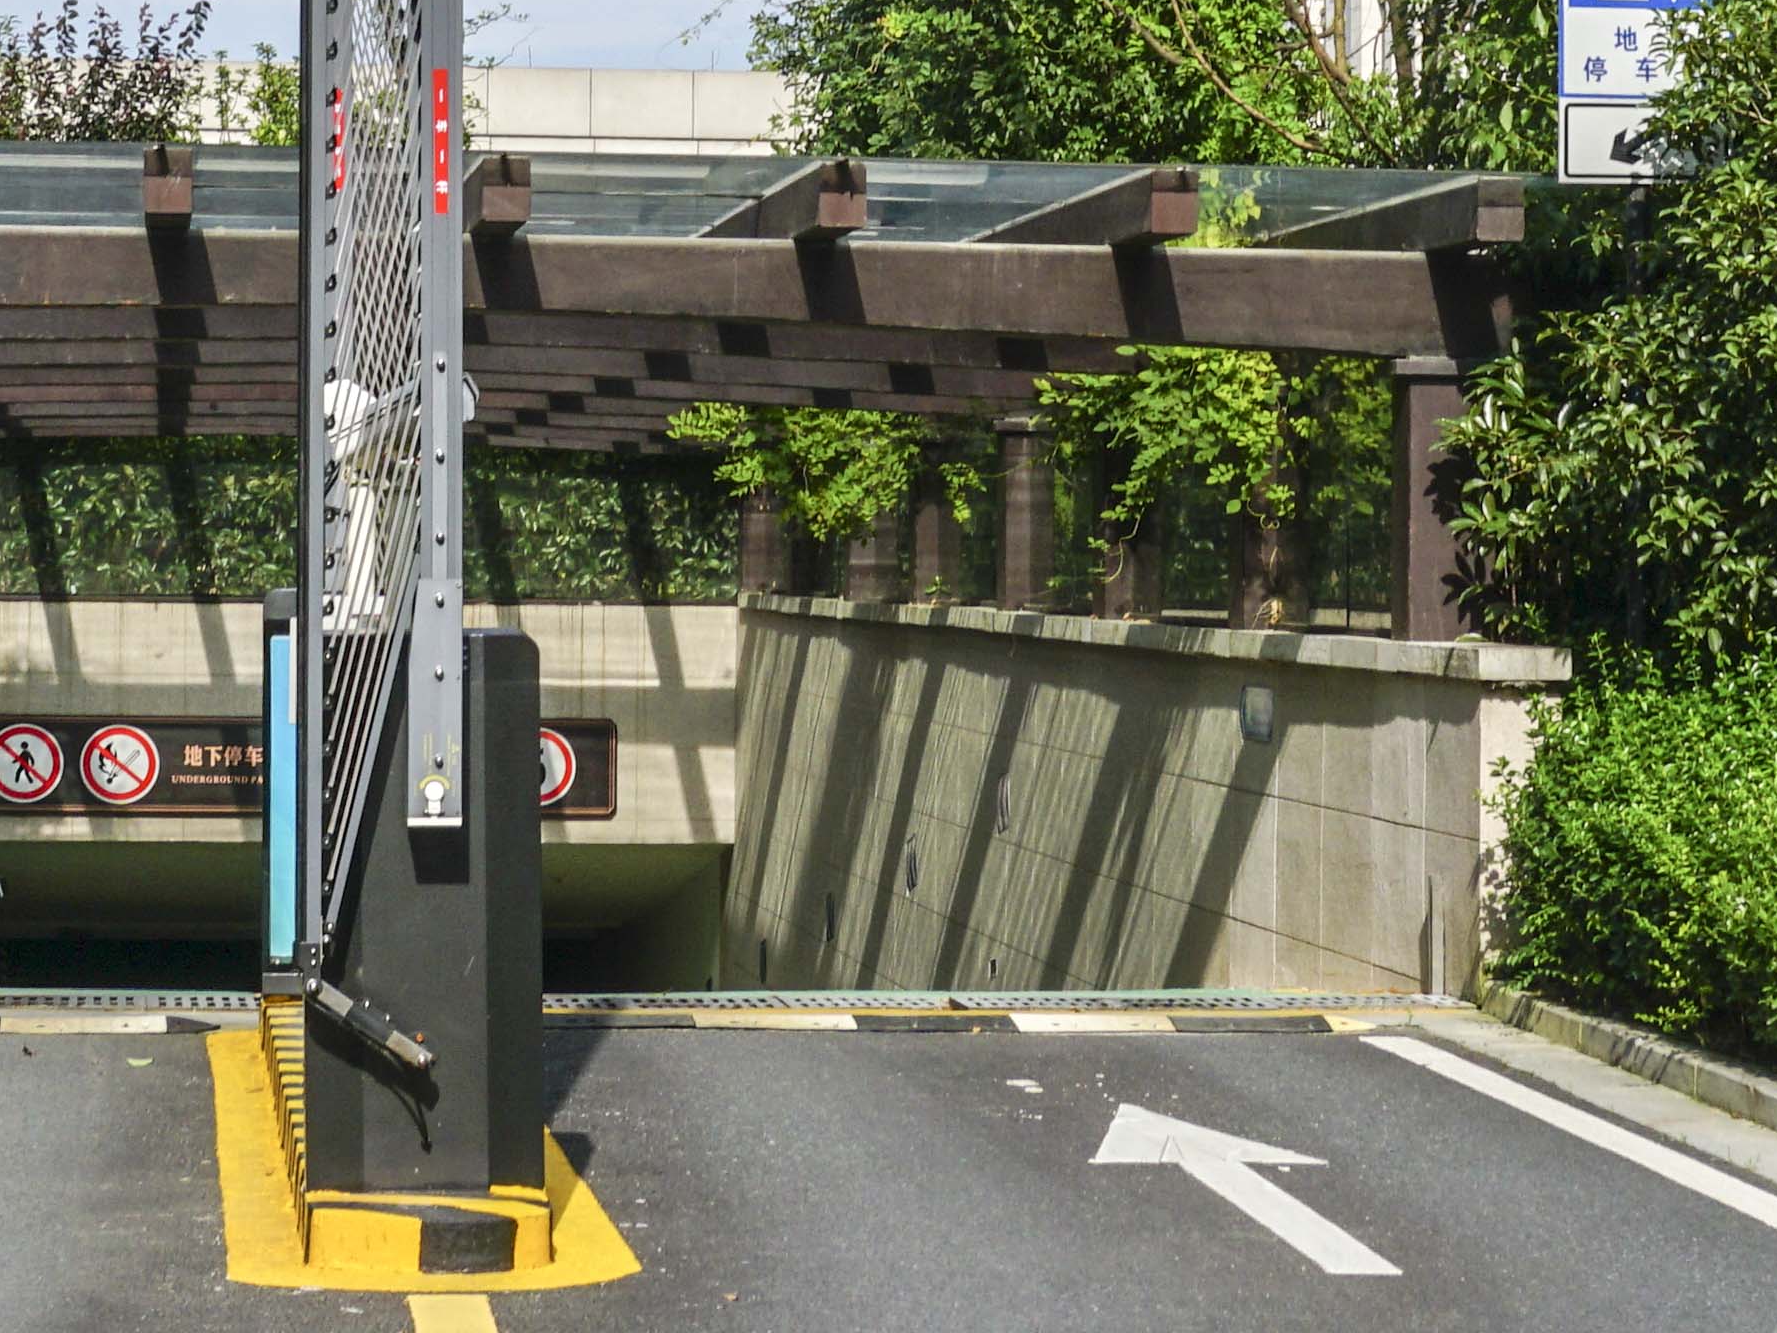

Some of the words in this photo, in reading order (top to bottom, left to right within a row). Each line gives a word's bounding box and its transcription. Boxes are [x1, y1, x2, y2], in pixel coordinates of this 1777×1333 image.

[1614, 26, 1638, 51] 地
[183, 744, 264, 767] 地下停车
[171, 775, 248, 785] UNDERGROUND
